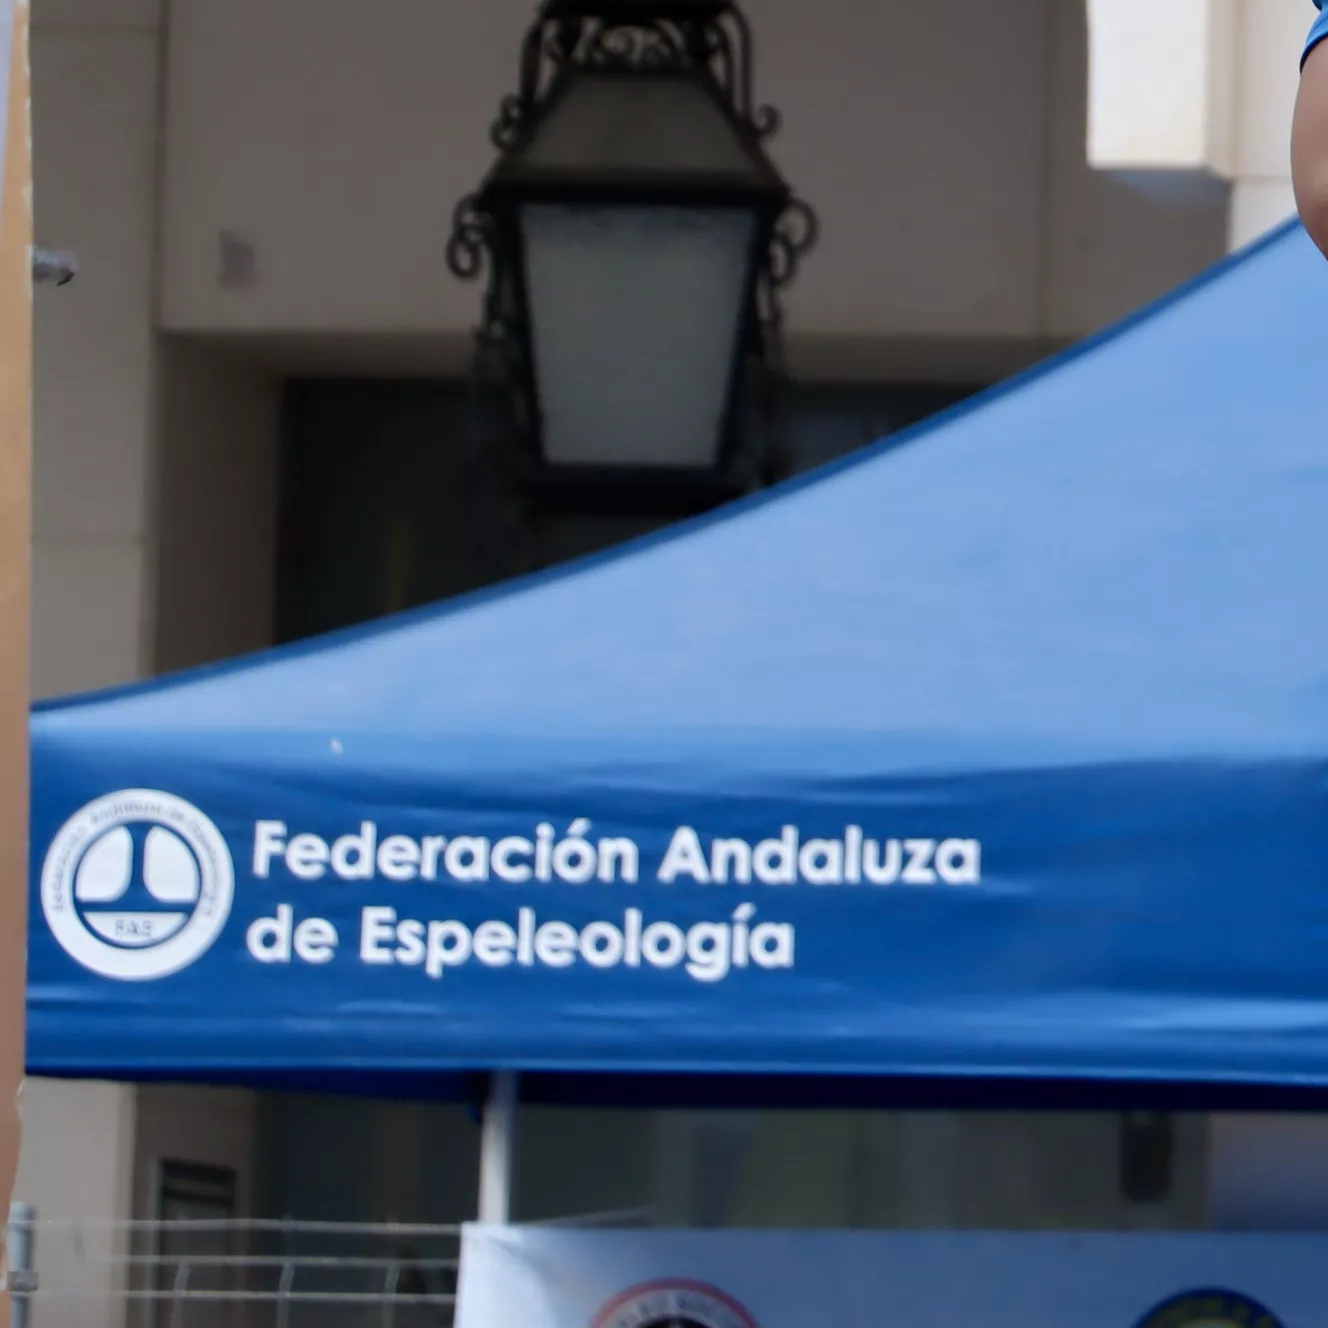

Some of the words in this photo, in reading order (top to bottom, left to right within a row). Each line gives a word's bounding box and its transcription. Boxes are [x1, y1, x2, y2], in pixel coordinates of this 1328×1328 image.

[252, 820, 637, 883] Federación
[660, 825, 981, 886] Andaluza
[247, 905, 336, 964] de
[359, 905, 795, 981] Espeleología
